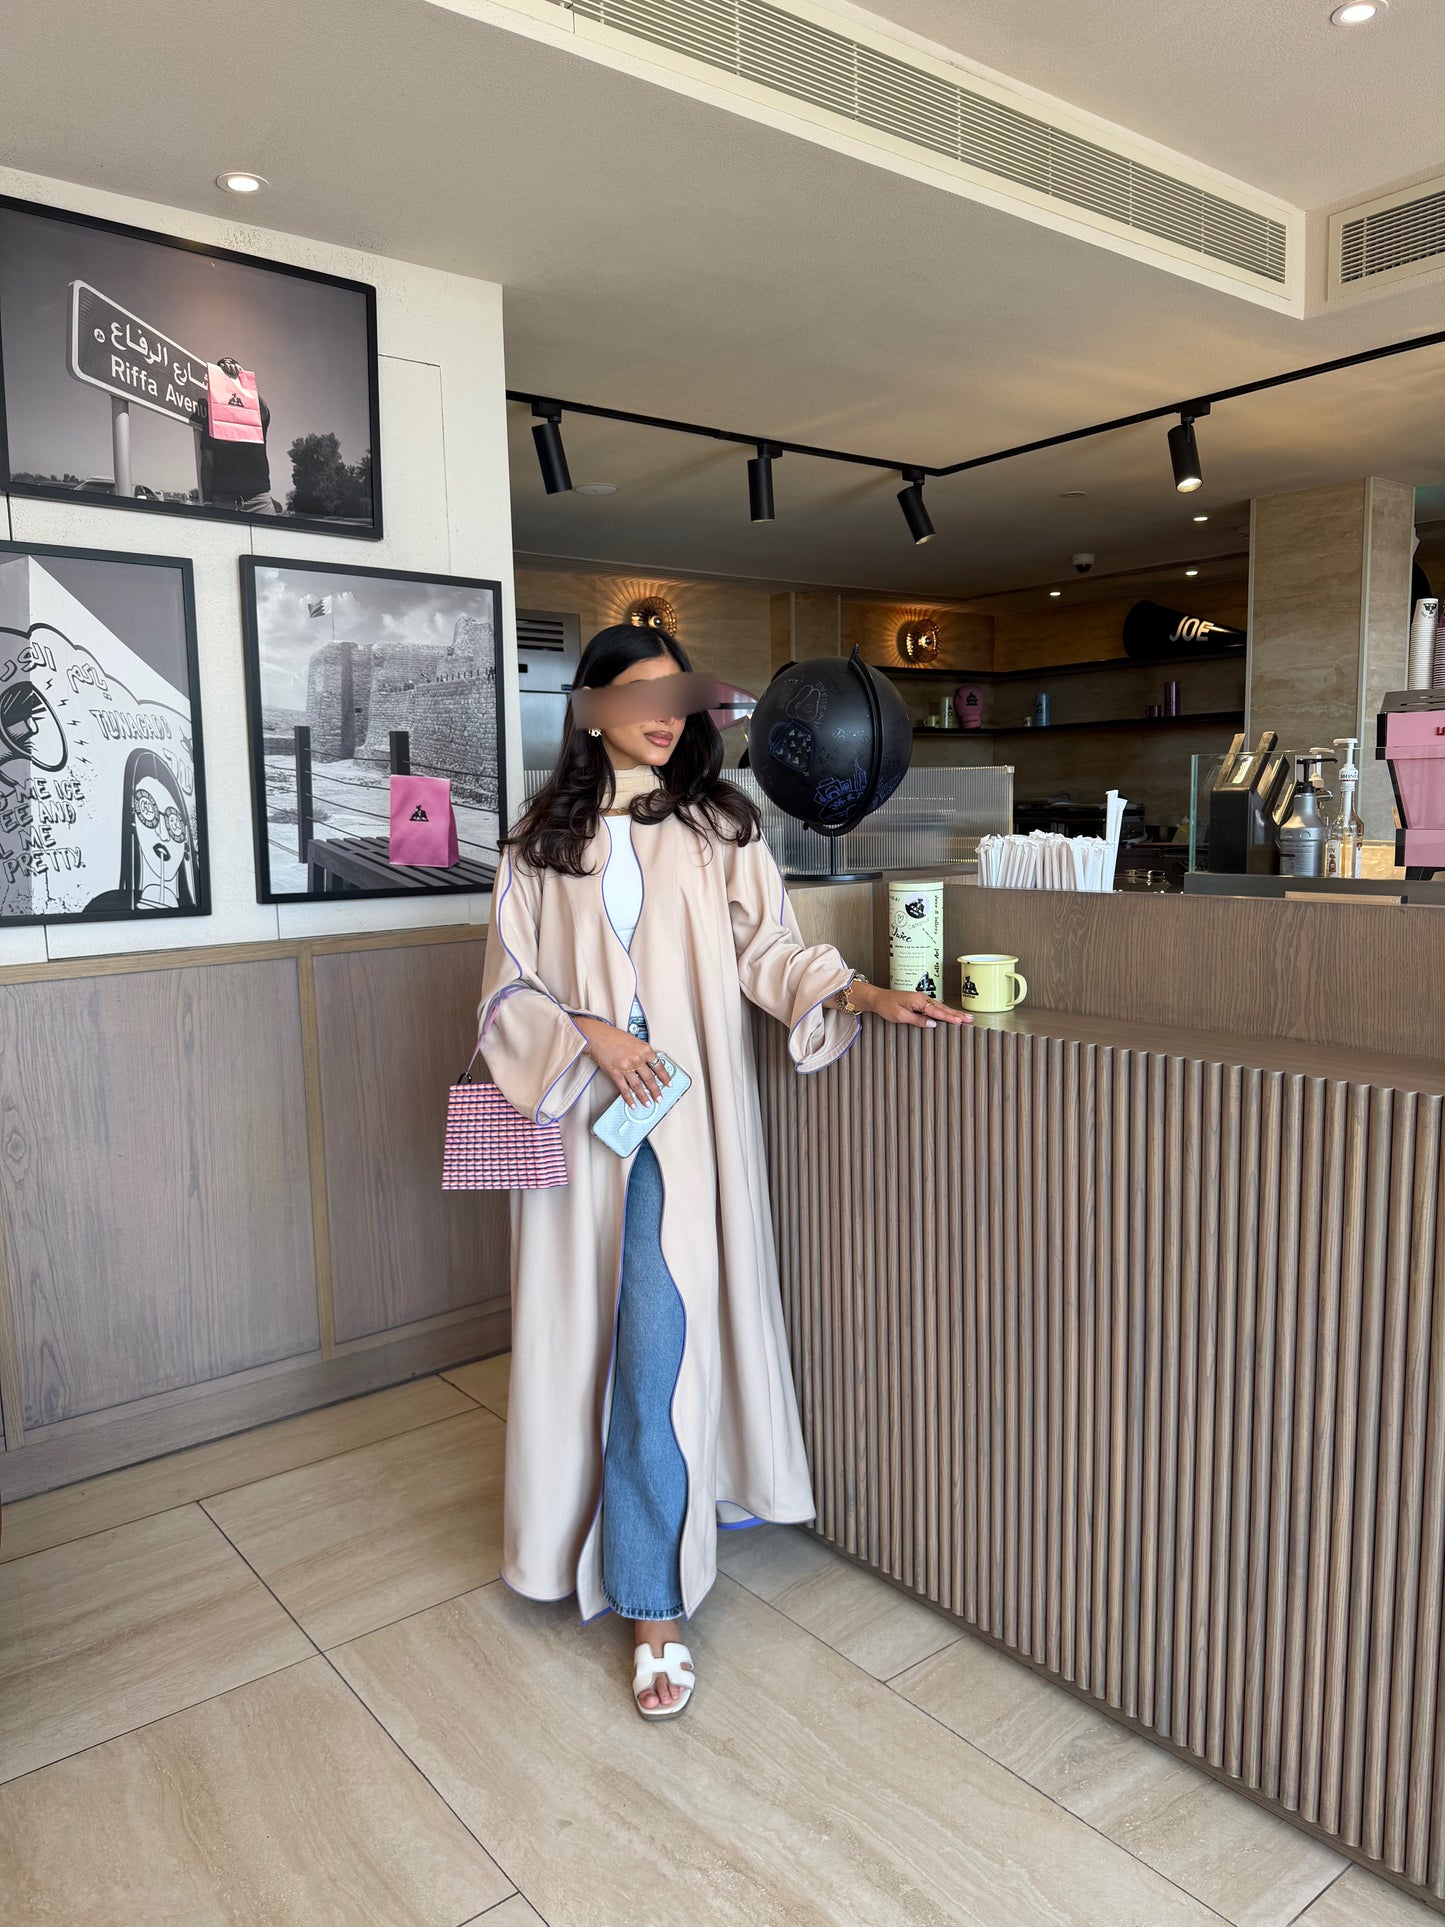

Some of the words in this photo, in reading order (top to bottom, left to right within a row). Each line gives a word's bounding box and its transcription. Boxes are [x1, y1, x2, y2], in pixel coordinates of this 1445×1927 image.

[111, 322, 168, 367] الرفاع
[111, 354, 158, 396] Riffa
[1169, 616, 1214, 641] JOE
[89, 709, 172, 741] TUNACADO
[15, 777, 51, 803] ME
[53, 779, 85, 801] ICE
[38, 800, 76, 824] AND
[18, 825, 56, 851] ME
[2, 847, 86, 884] PRETTY.
[892, 927, 912, 943] Juice
